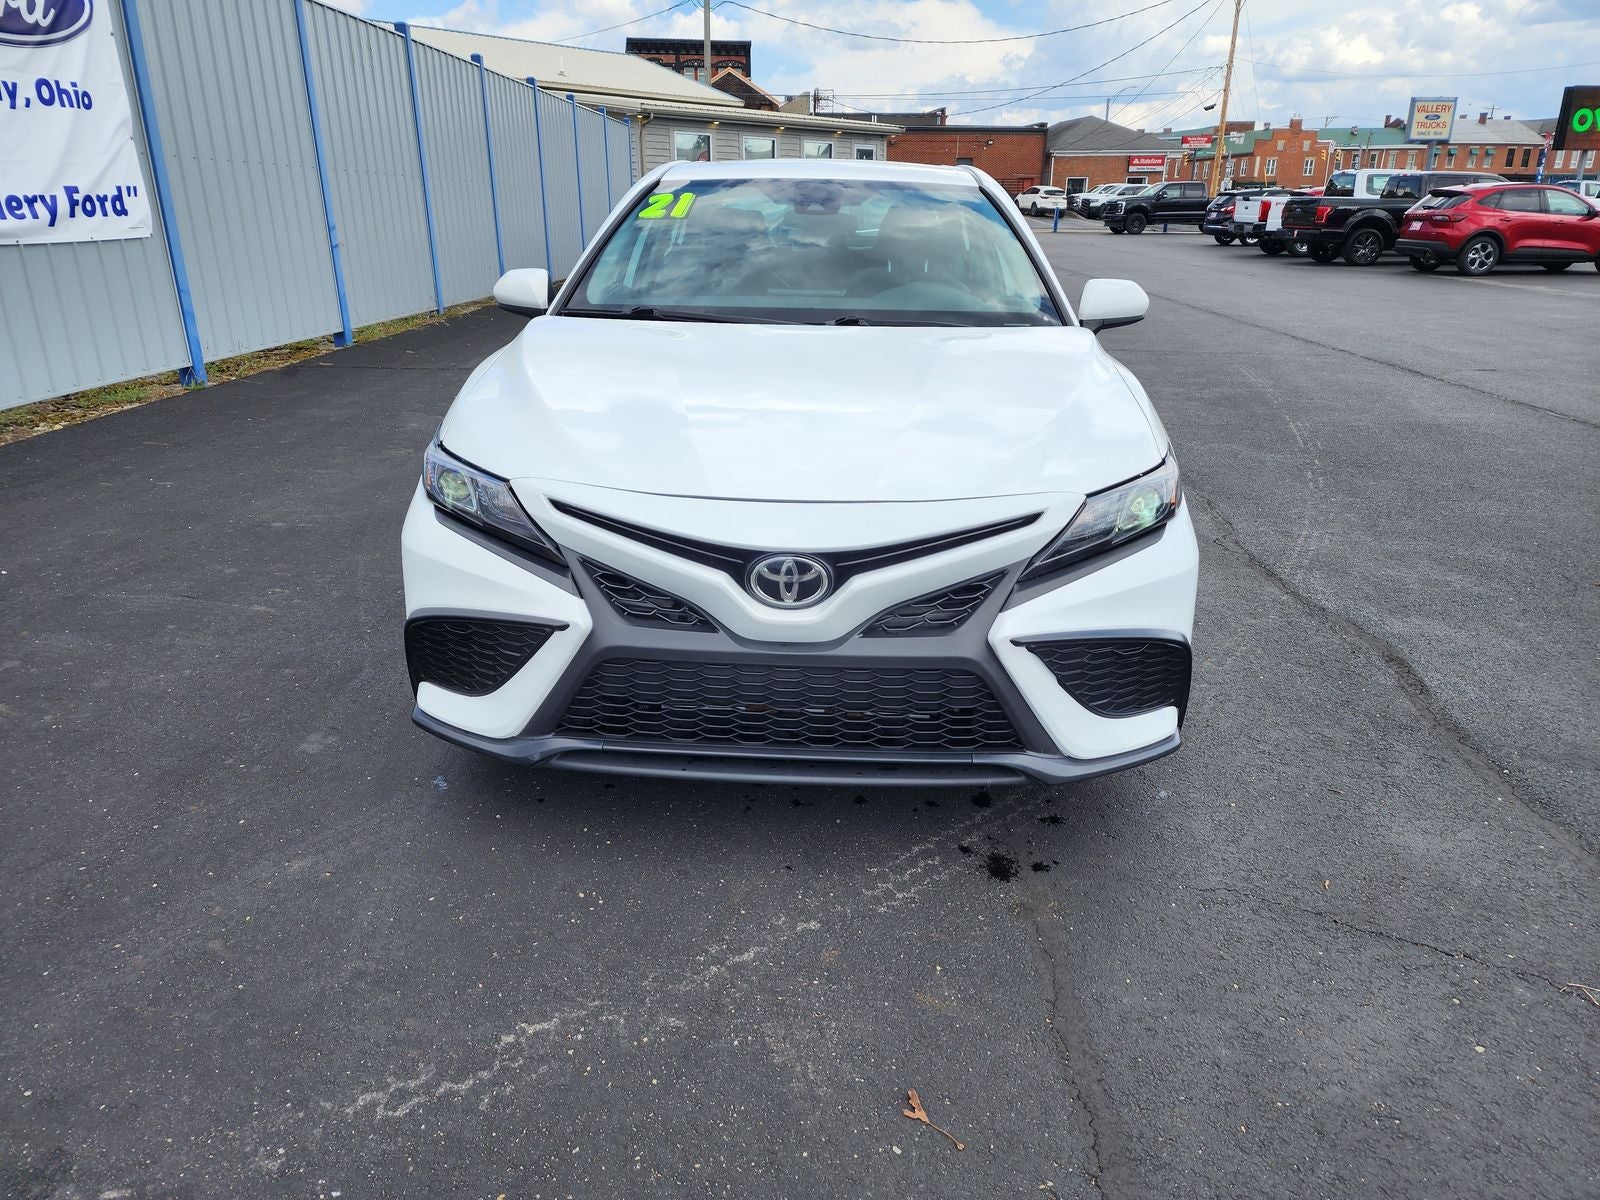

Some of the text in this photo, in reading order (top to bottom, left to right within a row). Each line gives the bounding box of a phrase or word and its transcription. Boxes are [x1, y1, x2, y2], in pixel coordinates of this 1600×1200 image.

[35, 78, 93, 110] Ohio
[1416, 104, 1453, 113] VALLERY
[1416, 121, 1447, 129] TRUCKS
[64, 185, 138, 219] Ford"
[638, 192, 696, 219] 21
